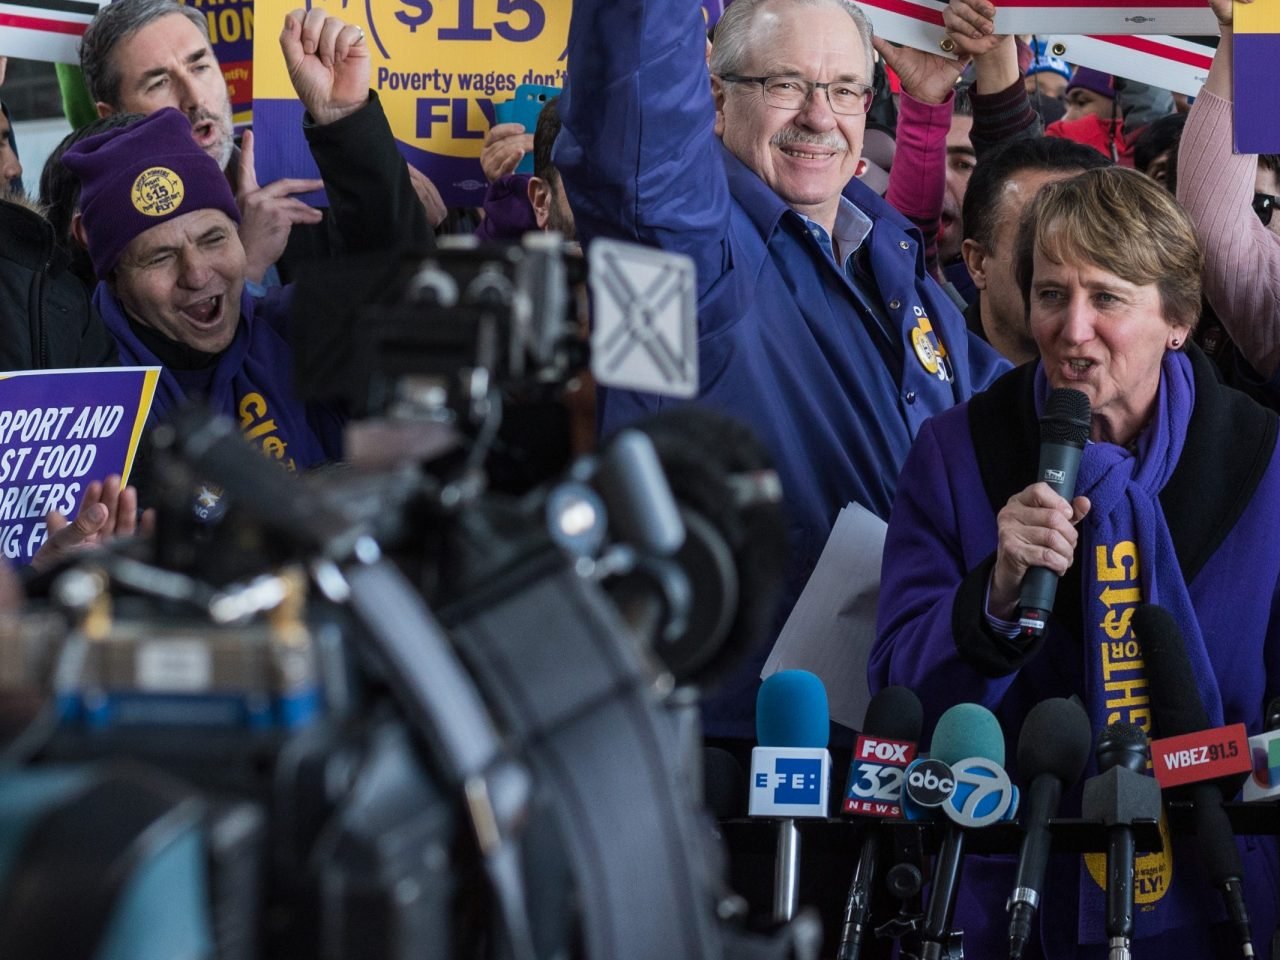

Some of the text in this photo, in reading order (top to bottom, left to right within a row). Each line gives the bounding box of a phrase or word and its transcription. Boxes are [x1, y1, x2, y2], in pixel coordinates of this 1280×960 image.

[377, 67, 516, 96] Poverty wages
[66, 405, 125, 440] AND
[27, 444, 97, 480] FOOD
[861, 740, 909, 763] FOX
[851, 765, 904, 802] 32
[909, 769, 955, 793] abc
[848, 800, 901, 815] NEWS
